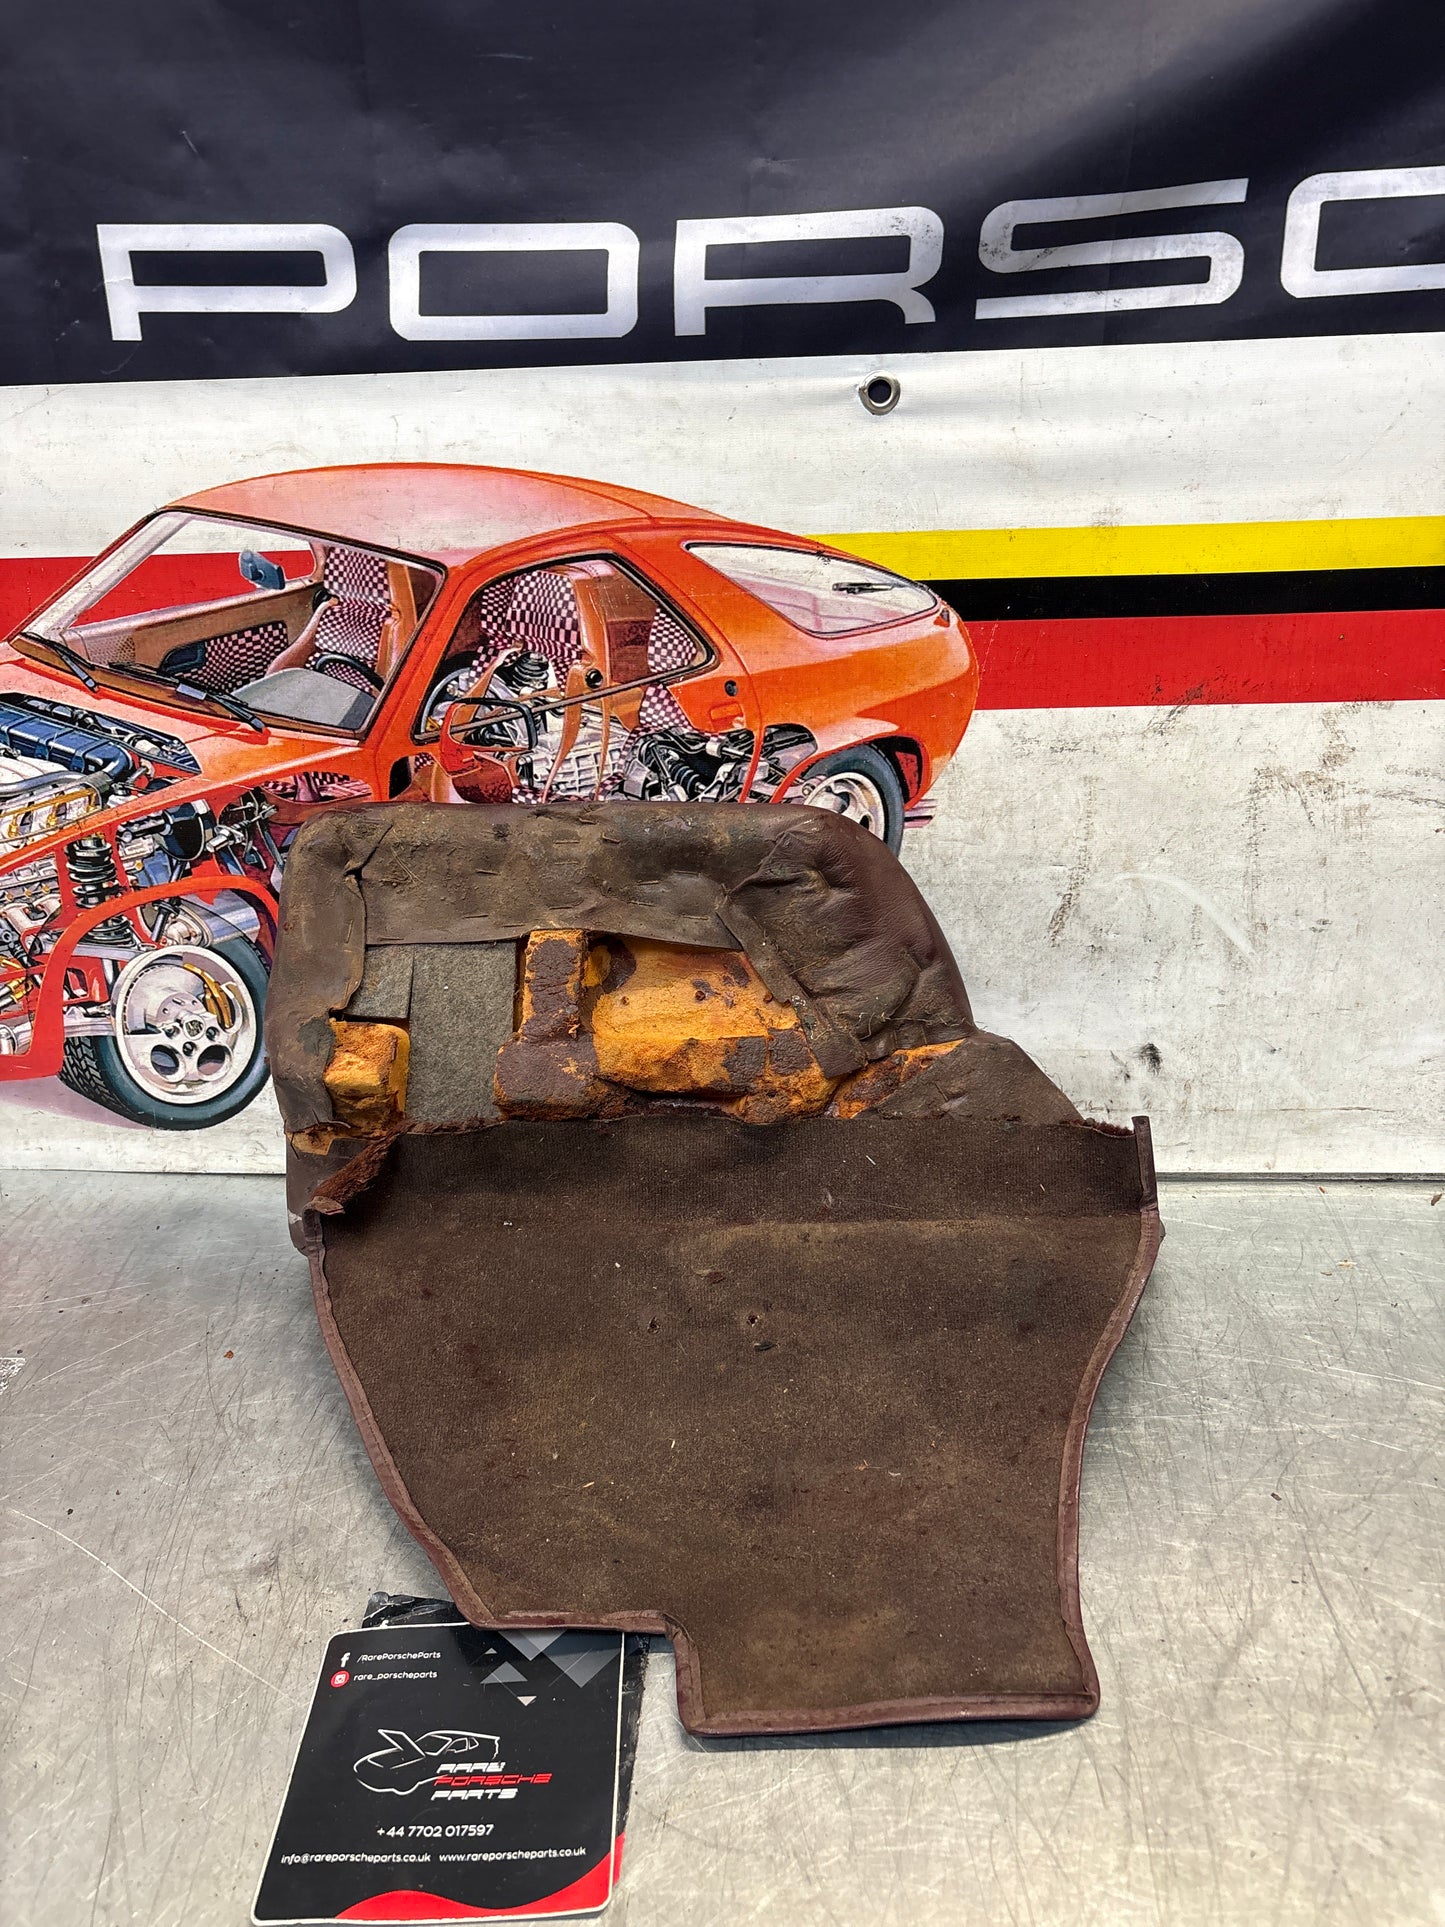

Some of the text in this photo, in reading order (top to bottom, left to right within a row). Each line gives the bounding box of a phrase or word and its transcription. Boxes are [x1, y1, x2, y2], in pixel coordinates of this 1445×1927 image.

[353, 1670, 438, 1681] rare_porscheparts
[436, 1761, 506, 1774] RARE
[433, 1773, 553, 1787] PORSCHE
[430, 1788, 519, 1801] PARTS
[377, 1824, 494, 1838] +44 7702 017597
[280, 1846, 586, 1865] info@rareporscheparts.co.uk www.rareporscheparts.co.uk
